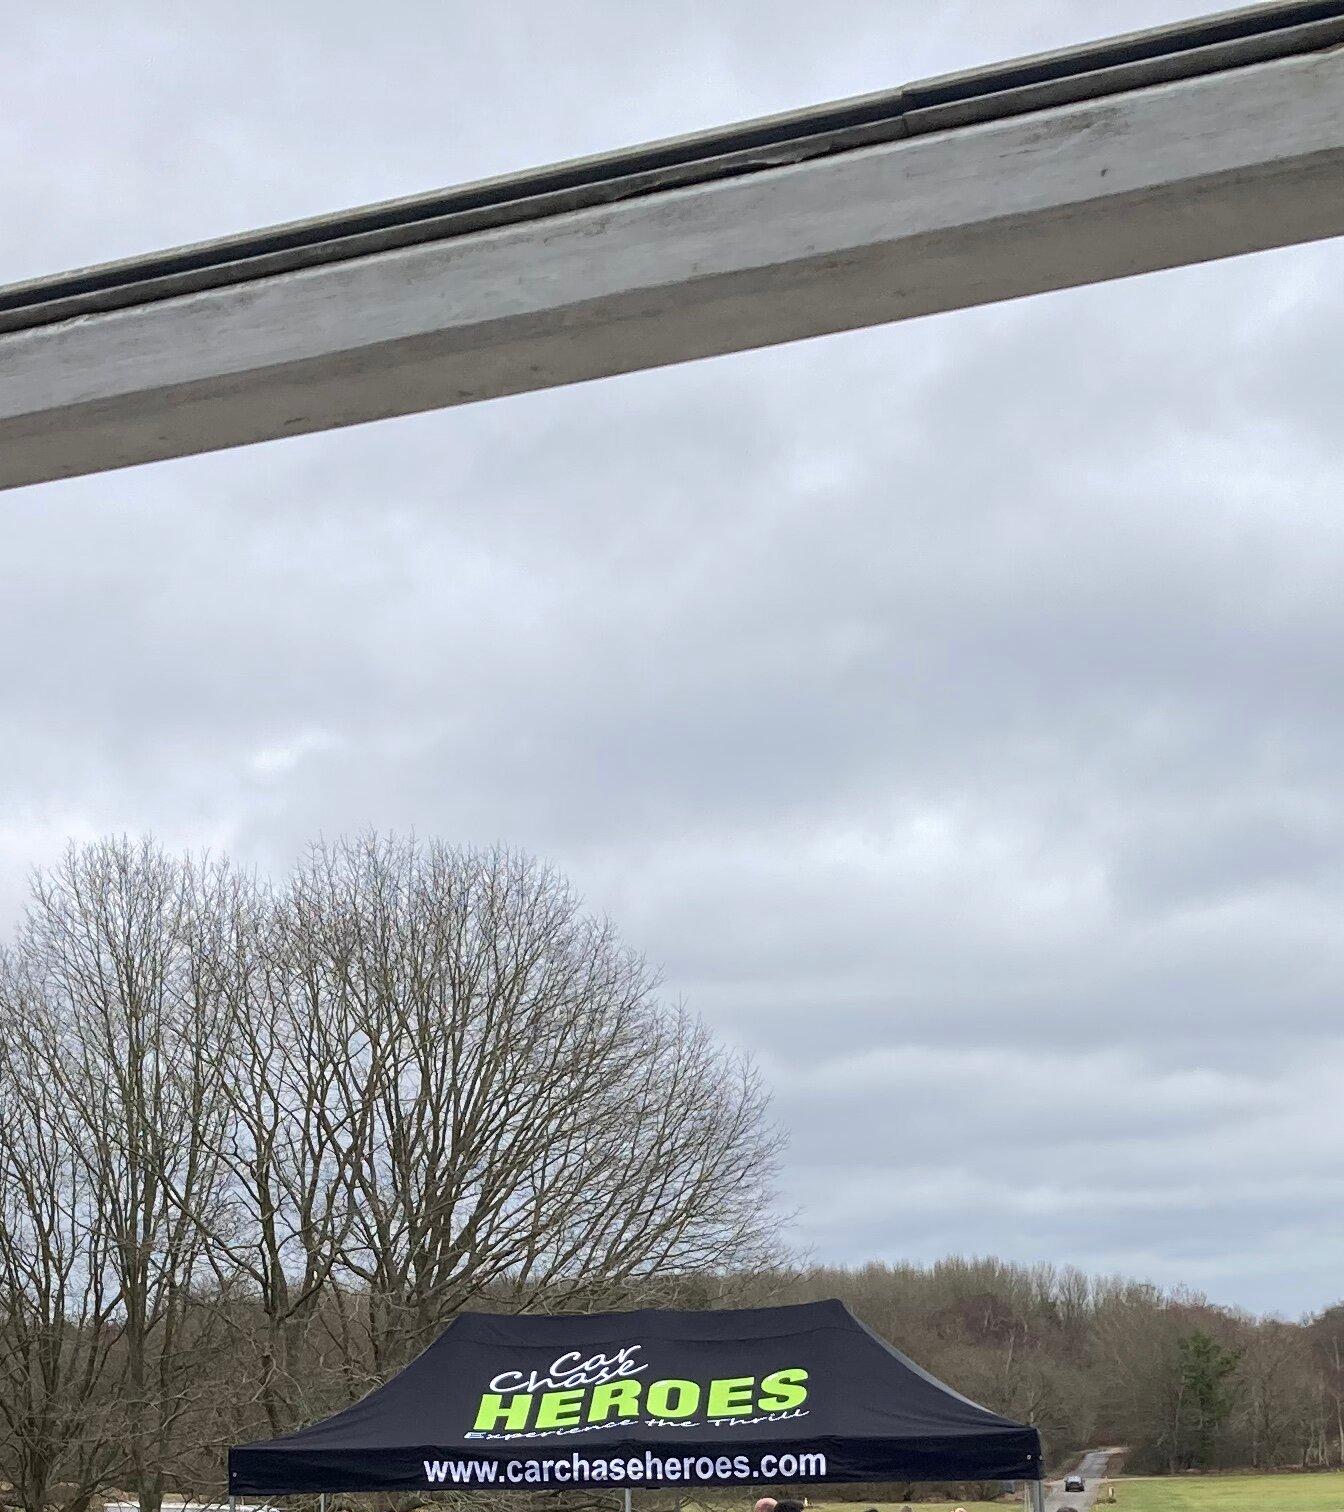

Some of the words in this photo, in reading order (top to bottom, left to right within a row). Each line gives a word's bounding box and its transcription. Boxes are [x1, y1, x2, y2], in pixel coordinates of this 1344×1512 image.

[489, 1359, 649, 1393] Chase
[549, 1344, 642, 1377] Car
[472, 1367, 810, 1433] HEROES
[422, 1450, 827, 1483] www.carchaseheroes.com
